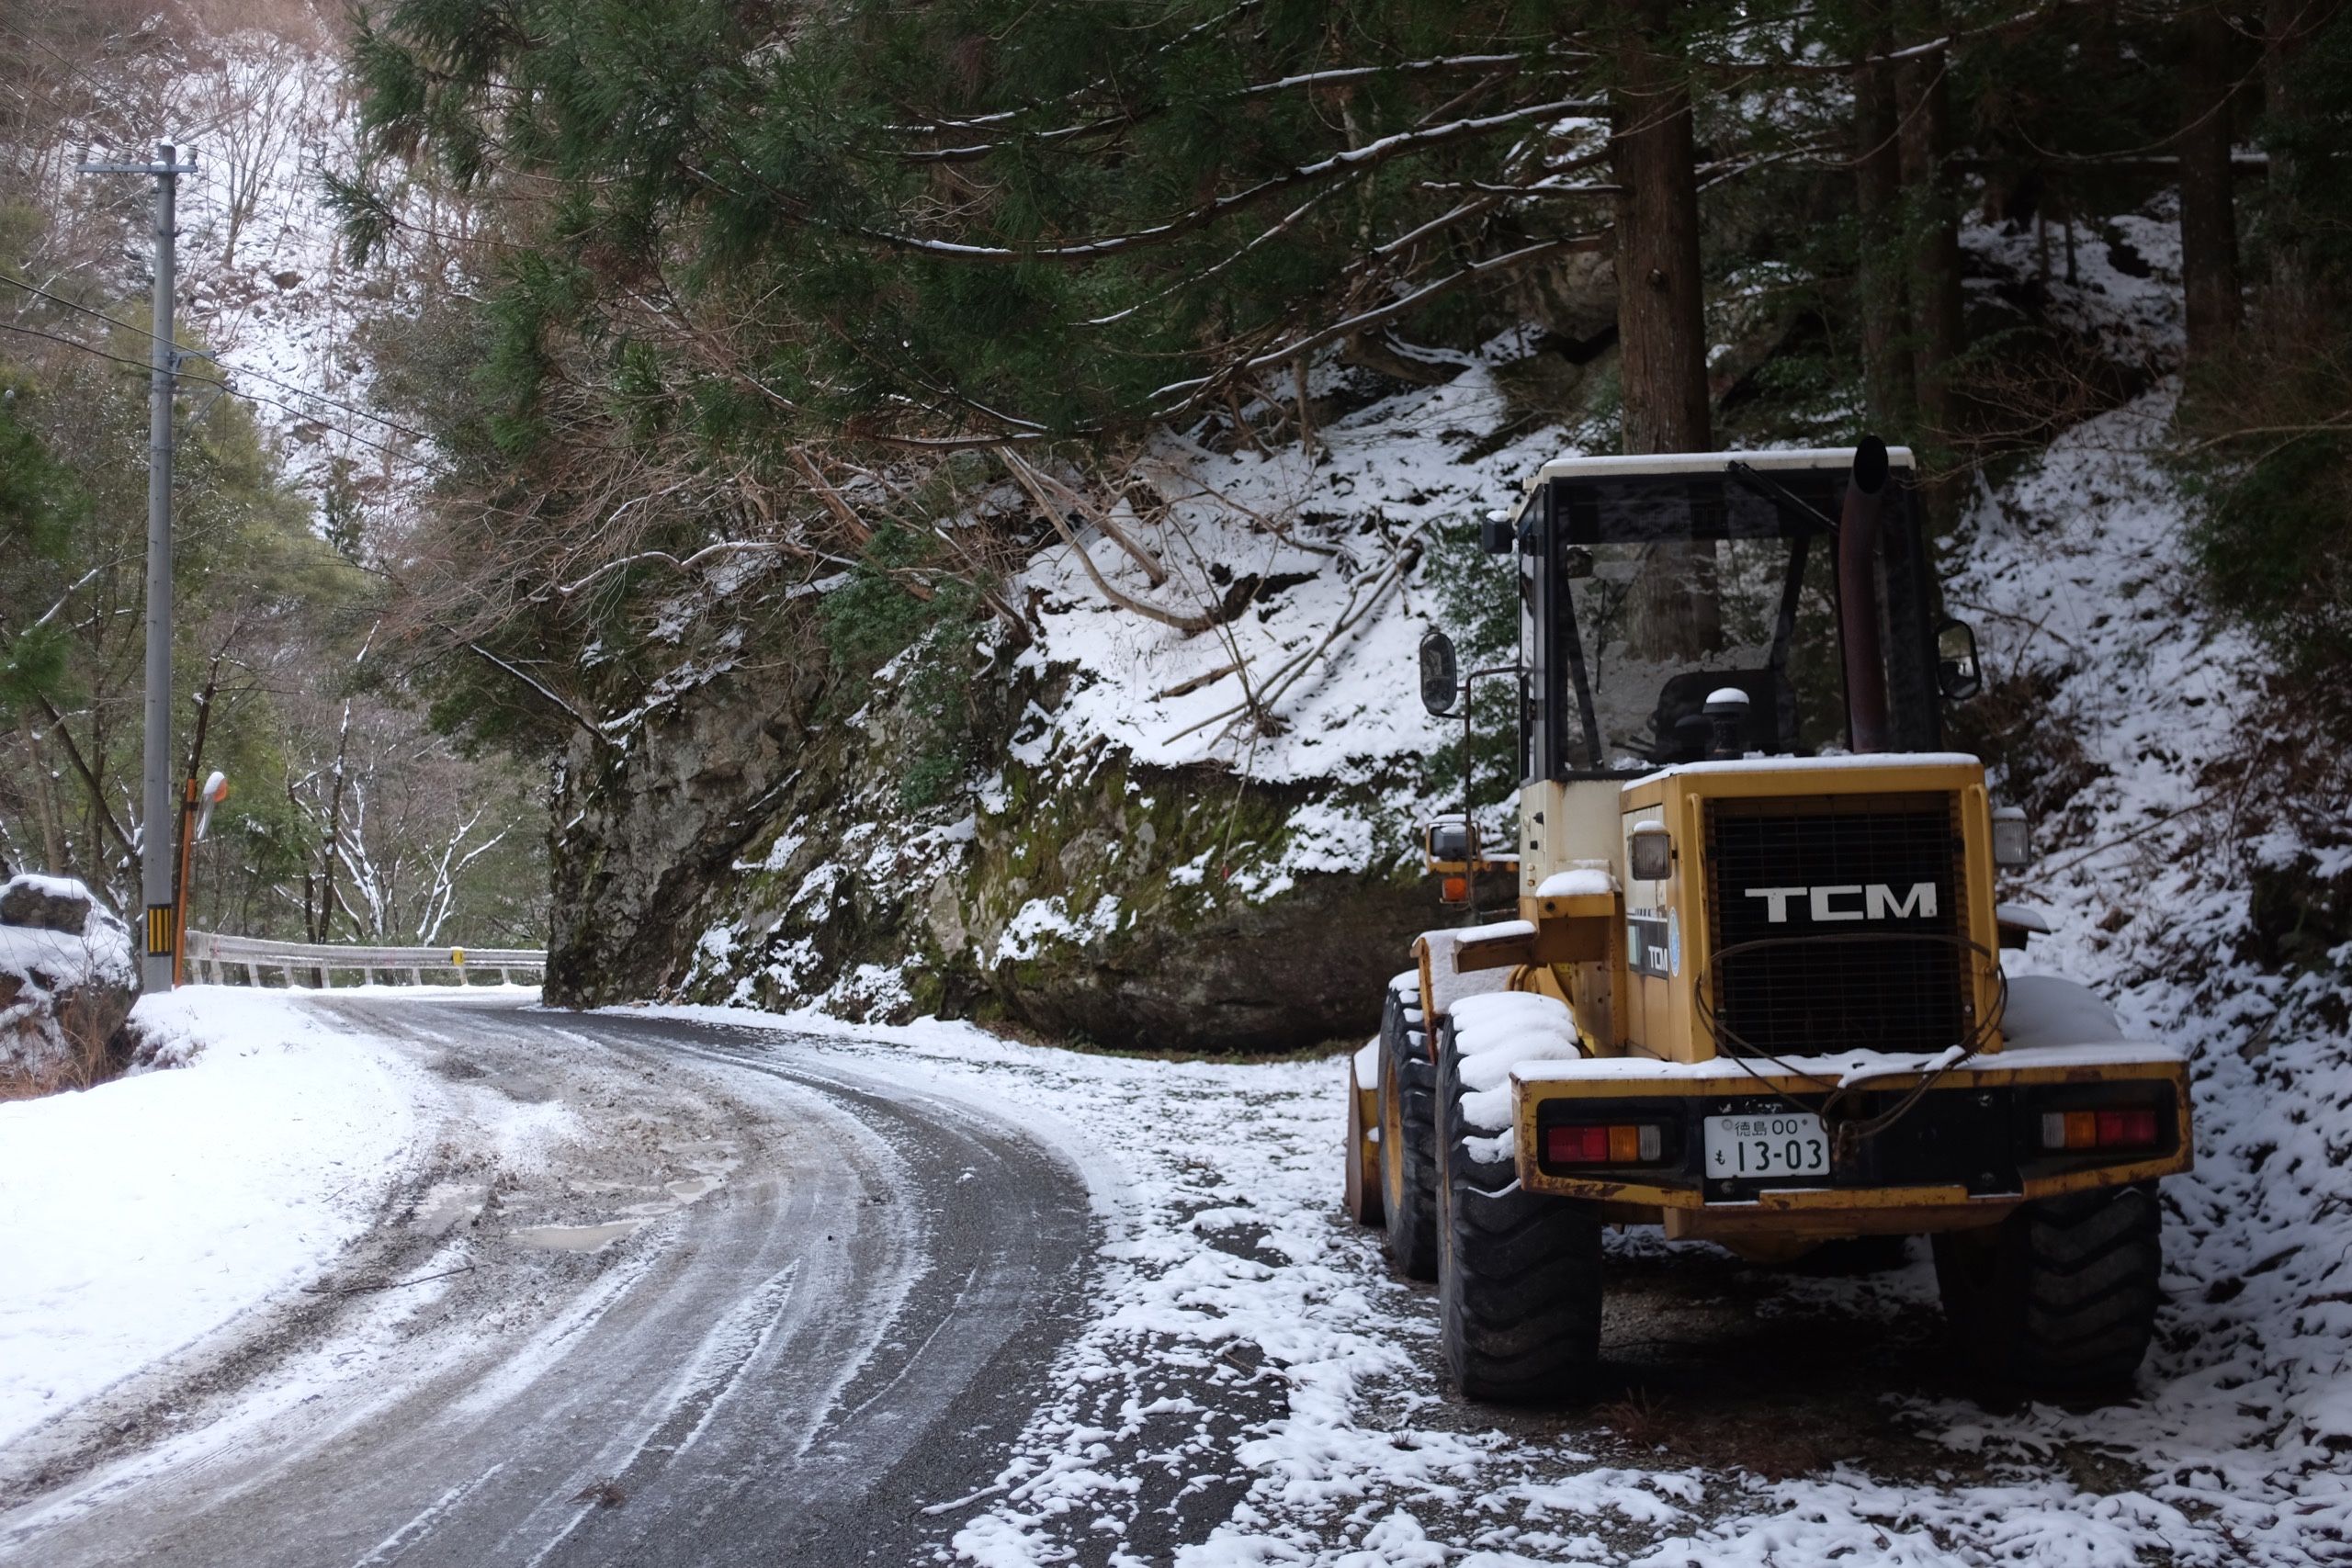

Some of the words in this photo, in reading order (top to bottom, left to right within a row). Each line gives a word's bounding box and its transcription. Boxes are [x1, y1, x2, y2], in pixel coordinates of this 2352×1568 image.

[1745, 882, 1938, 923] TCM
[1648, 945, 1668, 972] TCM
[1735, 1122, 1767, 1136] 徳島
[1715, 1150, 1725, 1165] も
[1739, 1140, 1822, 1171] 13-03
